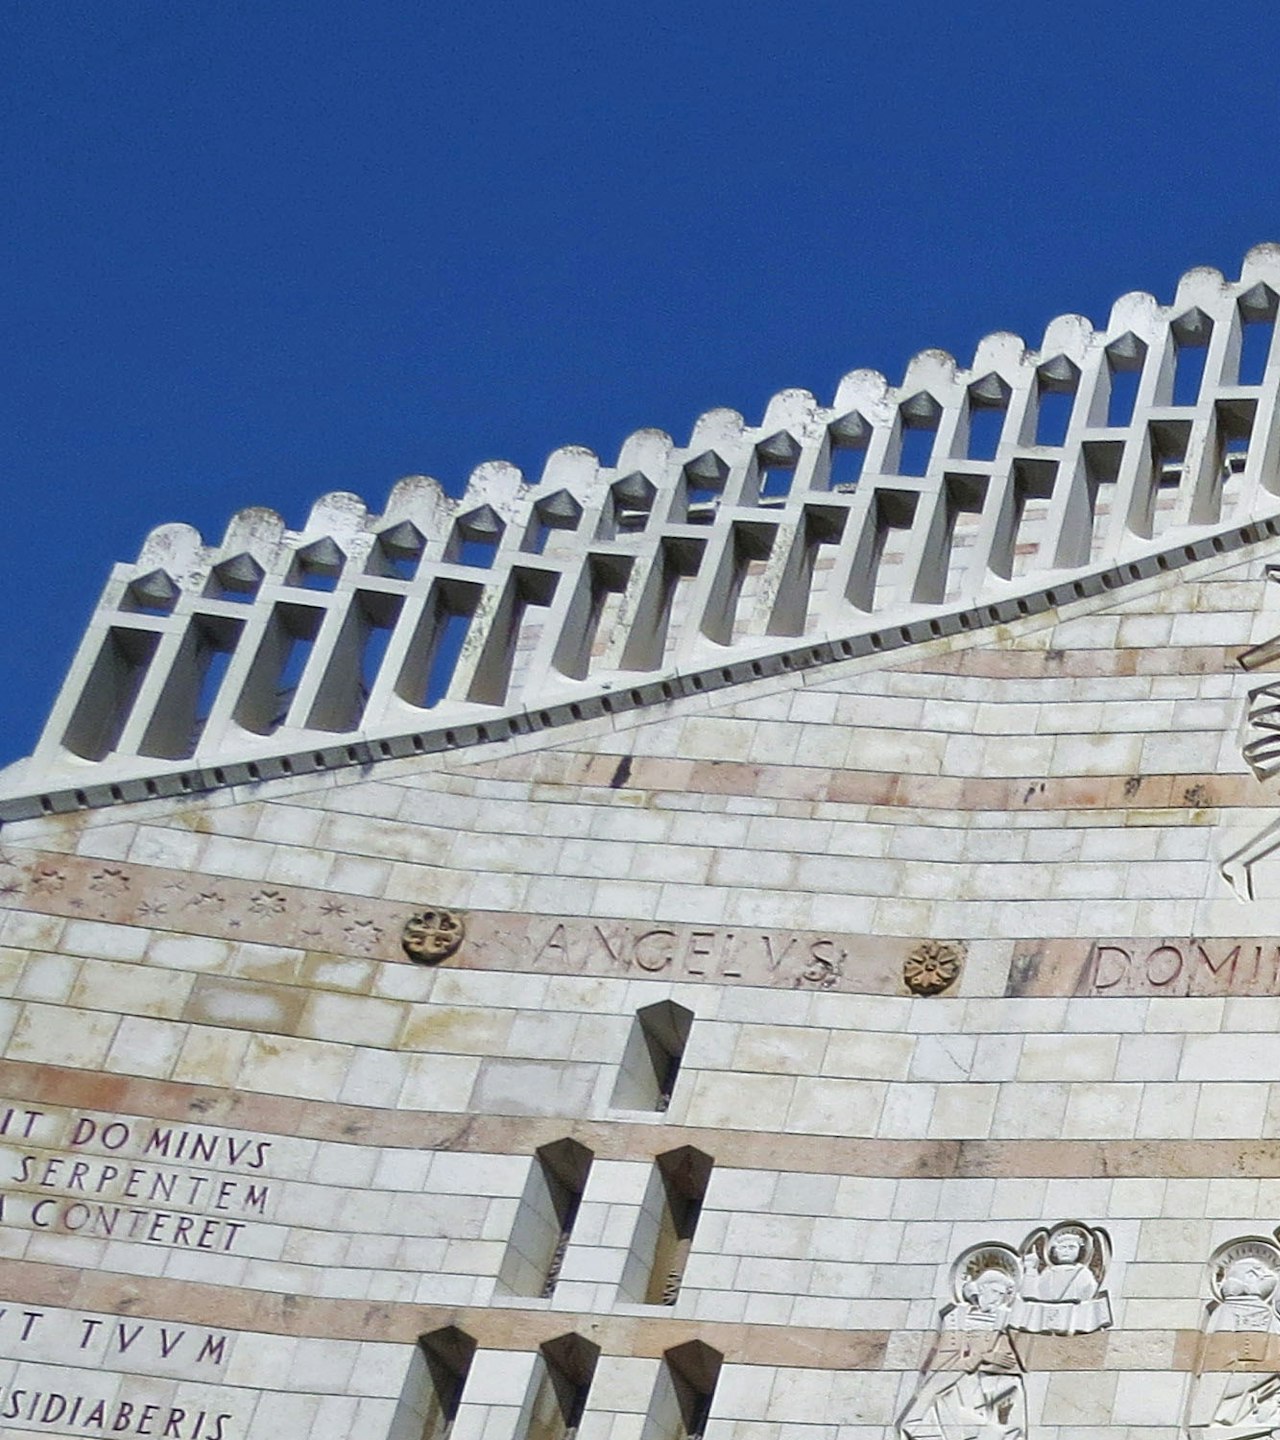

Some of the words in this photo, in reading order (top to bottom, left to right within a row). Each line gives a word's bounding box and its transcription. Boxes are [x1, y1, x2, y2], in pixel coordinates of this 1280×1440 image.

[534, 923, 835, 983] ANGELVS
[70, 1117, 273, 1169] DOMINVS
[13, 1155, 269, 1215] SERPENTEM
[31, 1199, 246, 1251] CONTERET
[80, 1319, 227, 1365] TVVM
